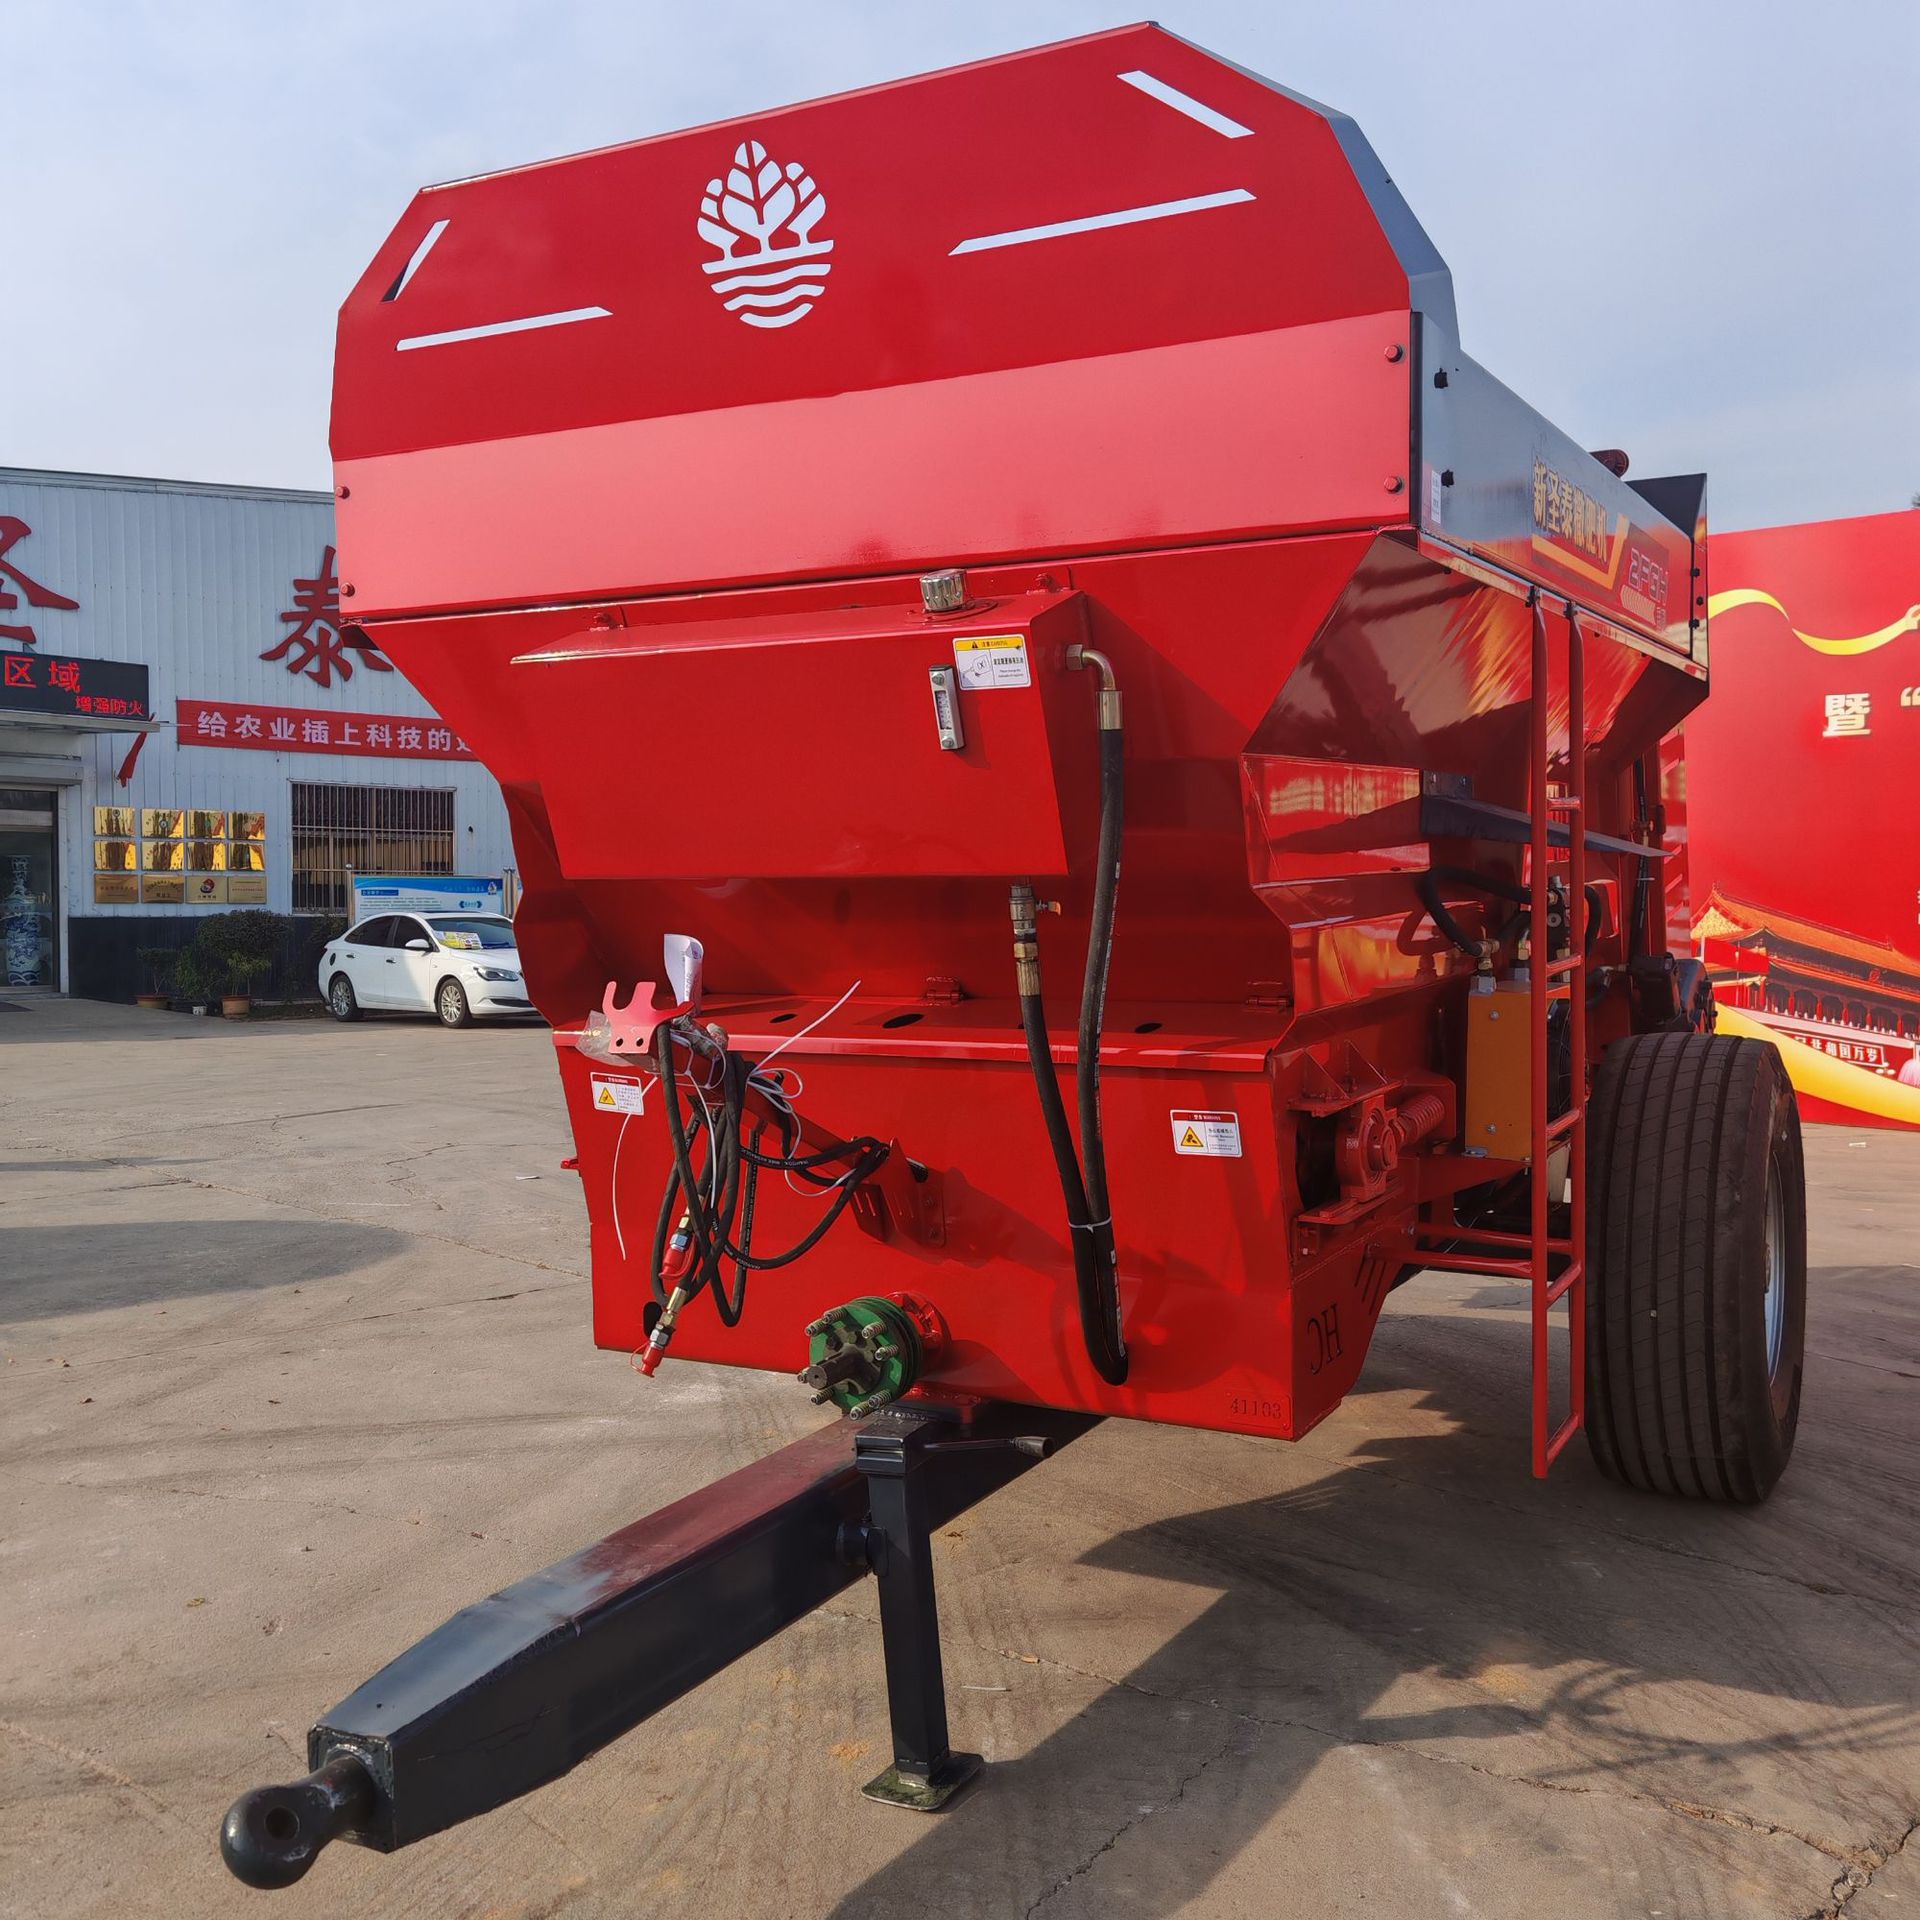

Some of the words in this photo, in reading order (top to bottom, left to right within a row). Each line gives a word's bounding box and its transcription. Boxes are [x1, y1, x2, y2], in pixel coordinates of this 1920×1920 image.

[4, 655, 81, 693] 区域
[75, 695, 144, 716] 增强防火
[1822, 693, 1871, 737] 暨
[197, 711, 473, 752] 给农业插上科技的
